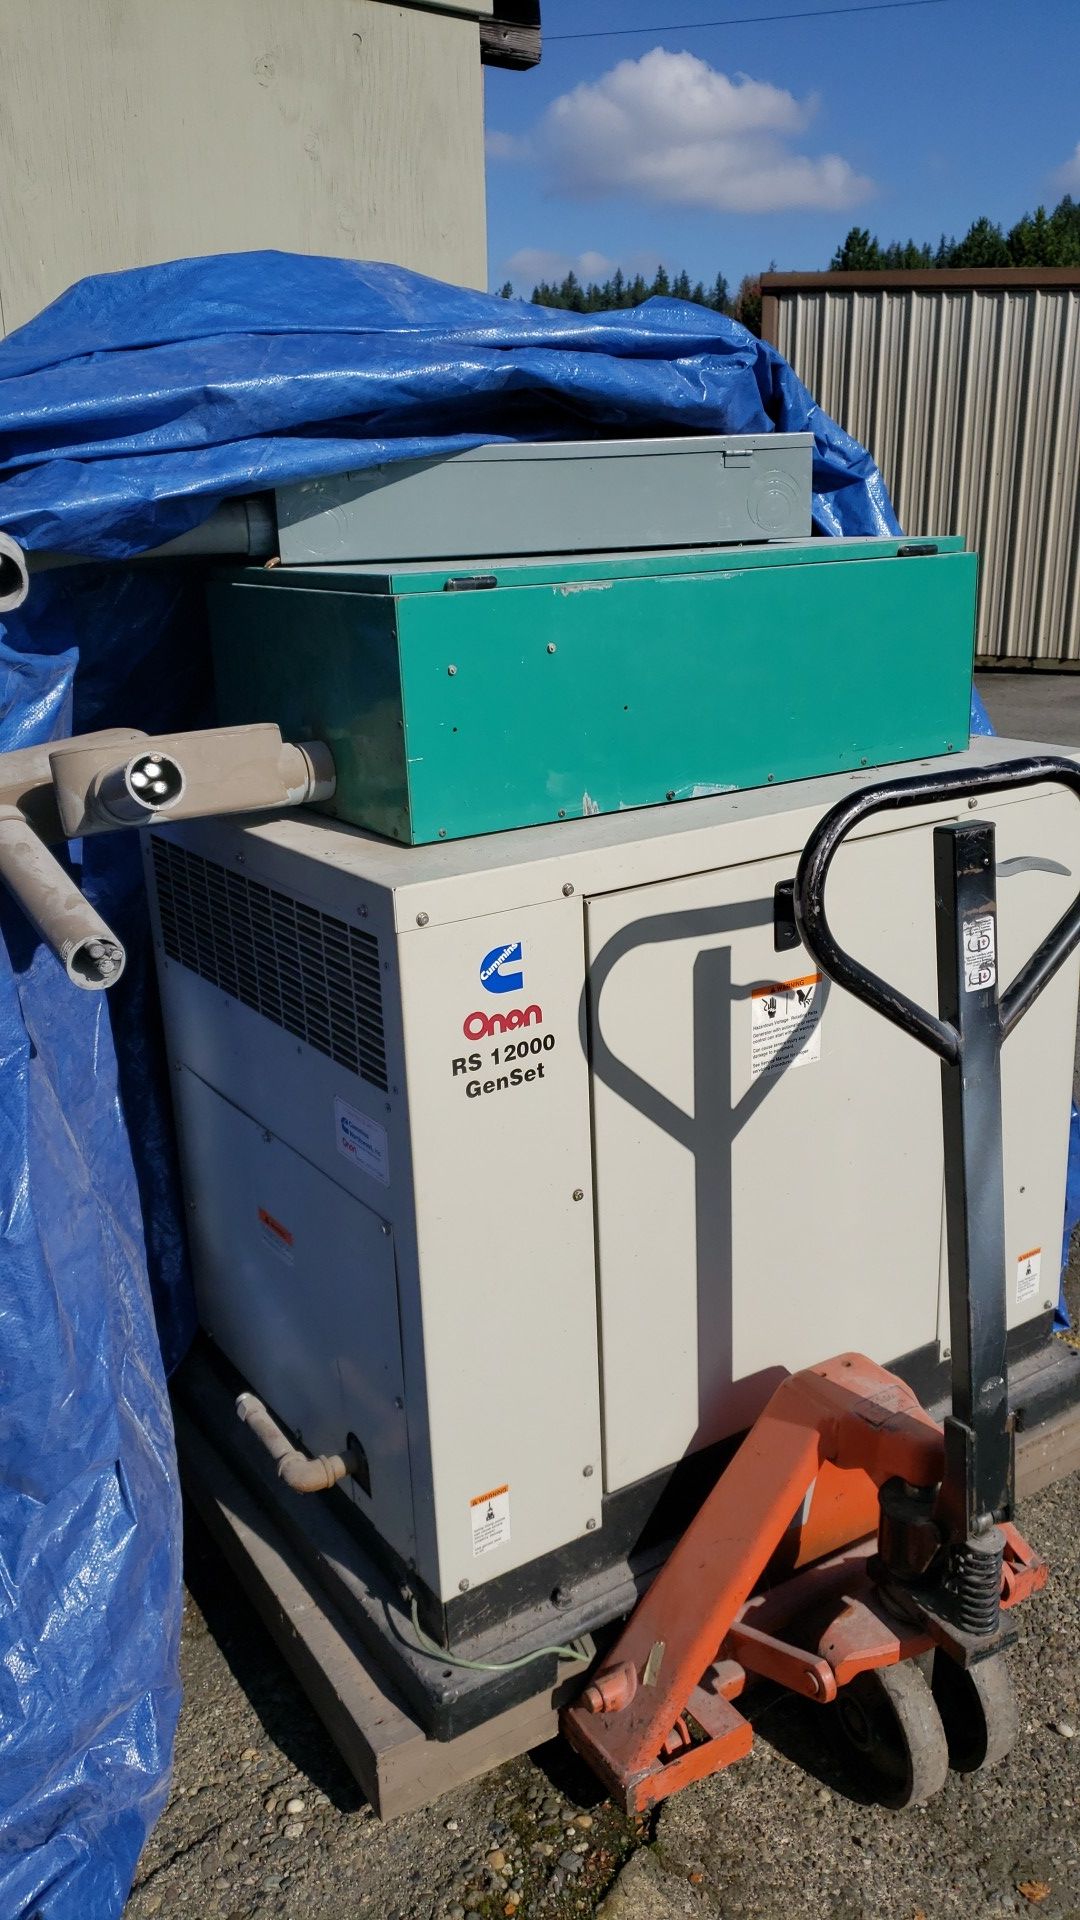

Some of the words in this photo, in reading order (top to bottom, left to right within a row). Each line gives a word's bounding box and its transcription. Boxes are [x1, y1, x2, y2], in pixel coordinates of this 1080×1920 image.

[480, 943, 518, 980] Cummins
[777, 980, 805, 992] WARNING
[463, 1004, 543, 1041] Onan
[753, 1023, 773, 1031] Hazardous
[791, 1012, 807, 1020] Rotating
[753, 1030, 772, 1038] Generator
[784, 1027, 799, 1035] without
[452, 1053, 483, 1077] RS
[491, 1033, 556, 1066] 12000
[753, 1051, 768, 1059] damage
[761, 1058, 774, 1066] Service
[775, 1053, 789, 1061] Manual
[465, 1062, 545, 1099] GenSet
